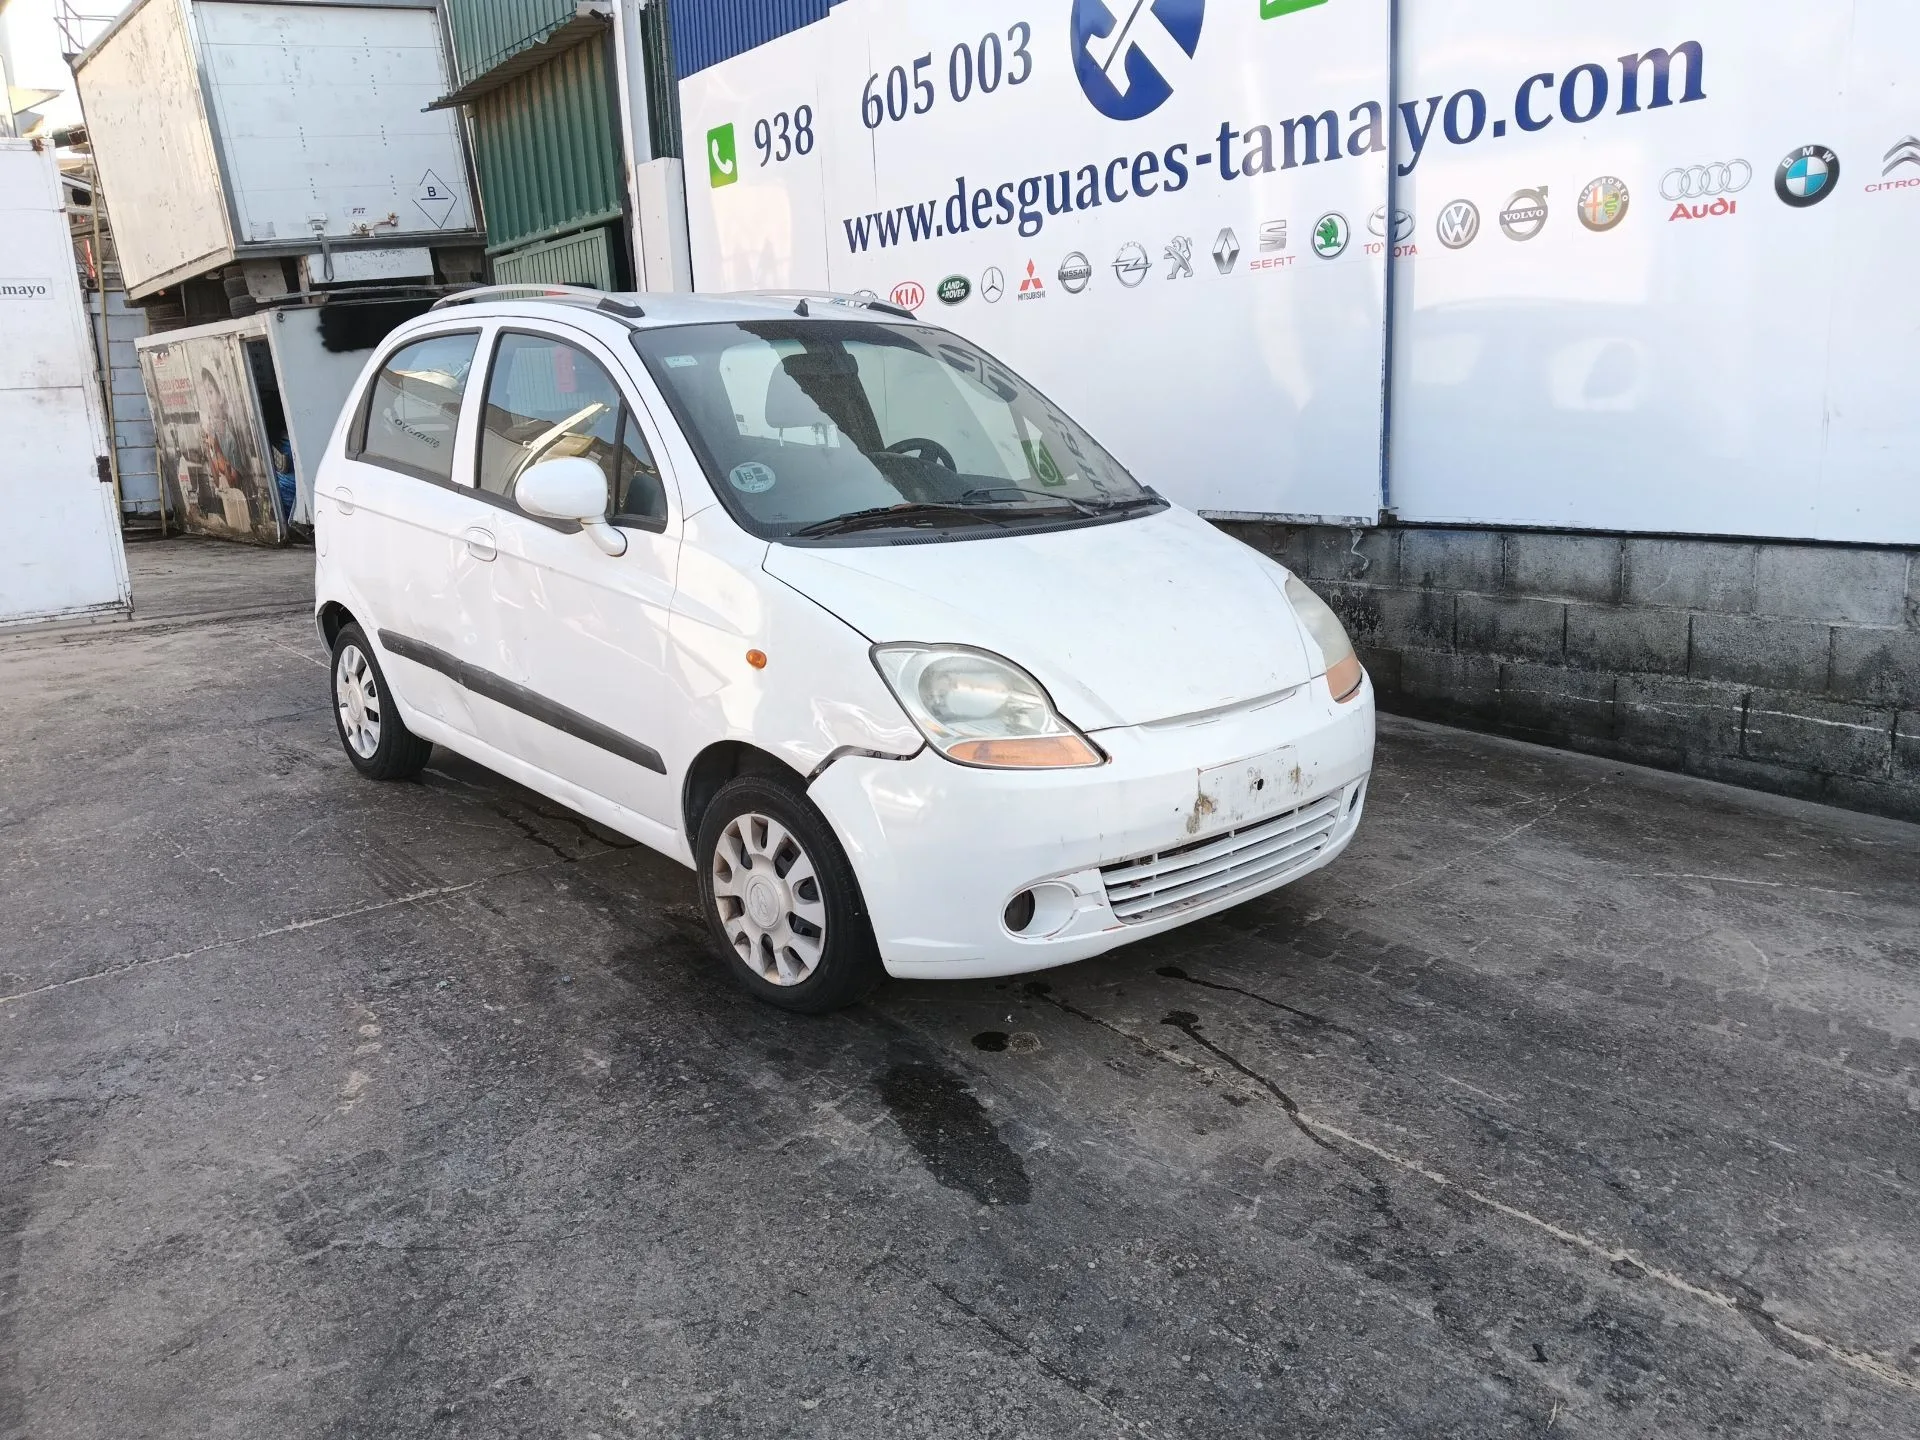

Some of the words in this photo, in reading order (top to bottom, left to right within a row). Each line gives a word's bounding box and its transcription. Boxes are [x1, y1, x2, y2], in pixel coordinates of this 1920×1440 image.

[754, 104, 814, 168] 938
[861, 51, 935, 129] 605
[949, 21, 1033, 103] 003
[1781, 146, 1835, 169] BMW
[427, 186, 437, 197] B
[1579, 184, 1596, 208] ALFA
[1601, 177, 1629, 203] ROMEO
[1503, 209, 1545, 221] VOLVO
[1250, 255, 1296, 271] SEAT
[1062, 268, 1089, 278] NISSAN
[0, 285, 46, 298] mayo
[943, 281, 960, 291] LAND
[895, 287, 919, 306] KIA
[945, 289, 966, 299] ROVER
[1017, 291, 1046, 302] MITSUBISHI
